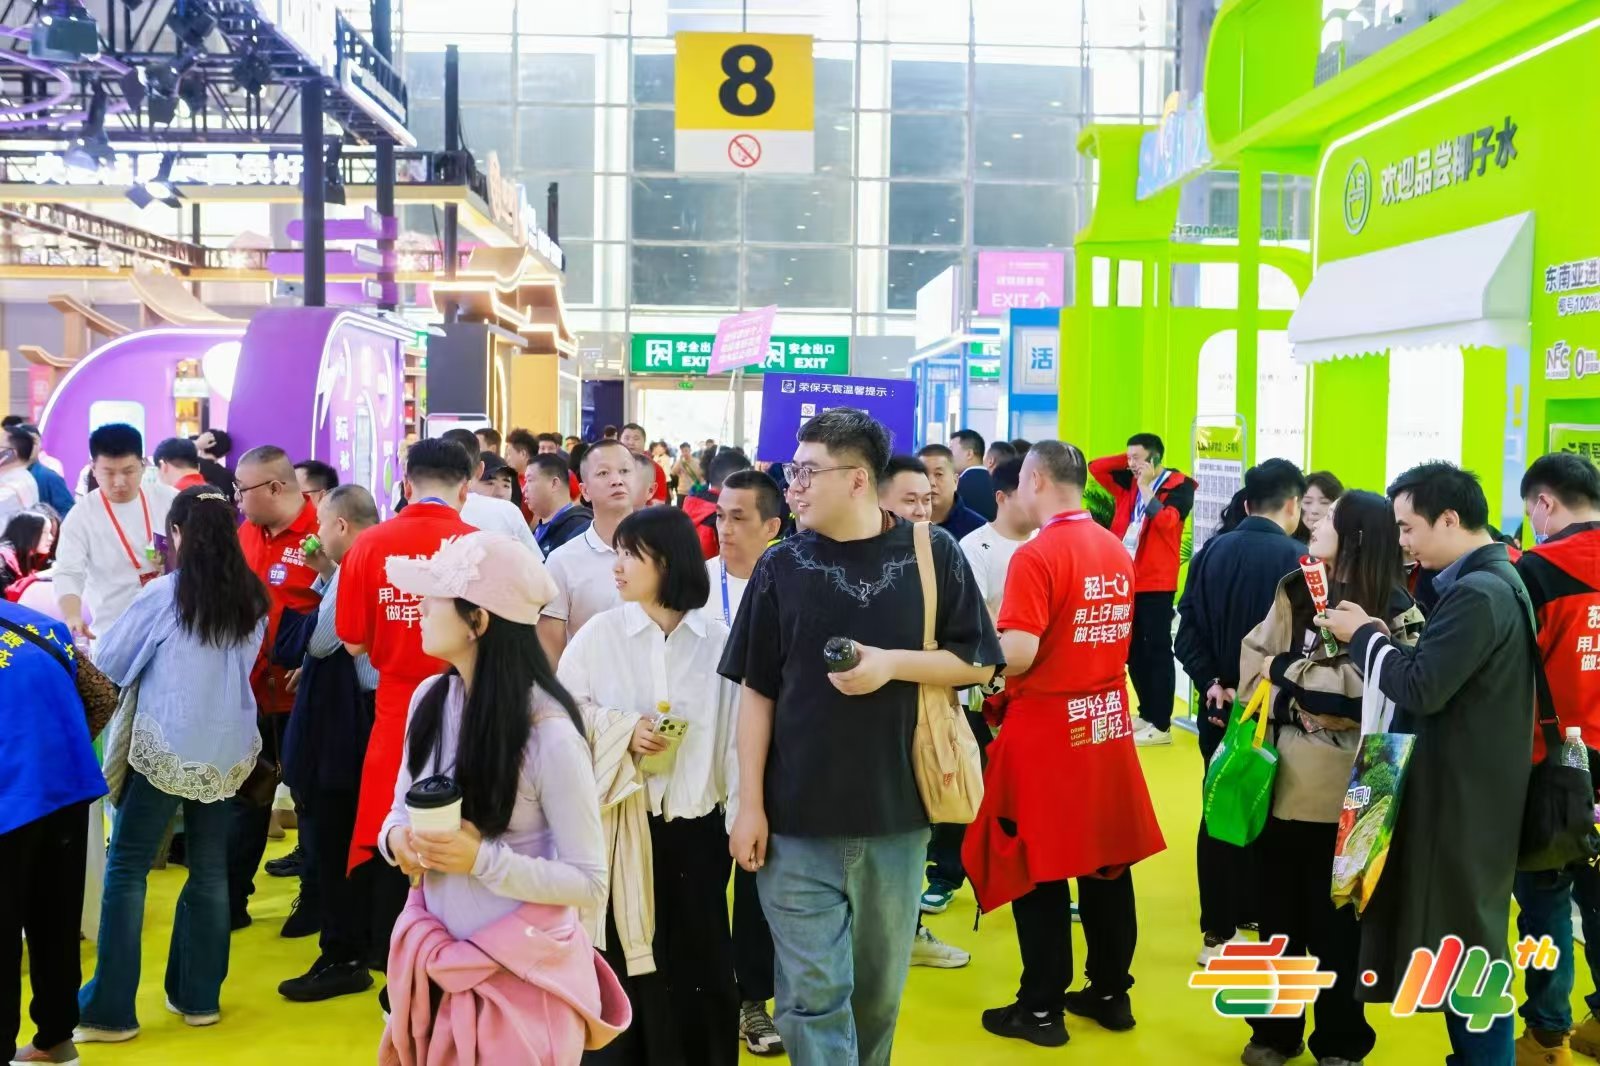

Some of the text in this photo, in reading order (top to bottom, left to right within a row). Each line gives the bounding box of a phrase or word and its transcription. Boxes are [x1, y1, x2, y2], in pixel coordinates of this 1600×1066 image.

[718, 44, 775, 117] 8
[1380, 116, 1518, 206] 欢迎品尝椰子水
[1545, 260, 1600, 292] 东南亚进
[992, 293, 1029, 307] EXIT
[676, 341, 711, 353] 安全出
[788, 343, 835, 355] 安全出口
[1031, 347, 1053, 369] 活
[1546, 342, 1568, 370] NFC
[794, 357, 829, 369] EXIT
[385, 605, 424, 629] 做年
[1580, 654, 1600, 672] 做
[1070, 732, 1086, 740] LIGHT
[1091, 711, 1132, 744] 喝轻上
